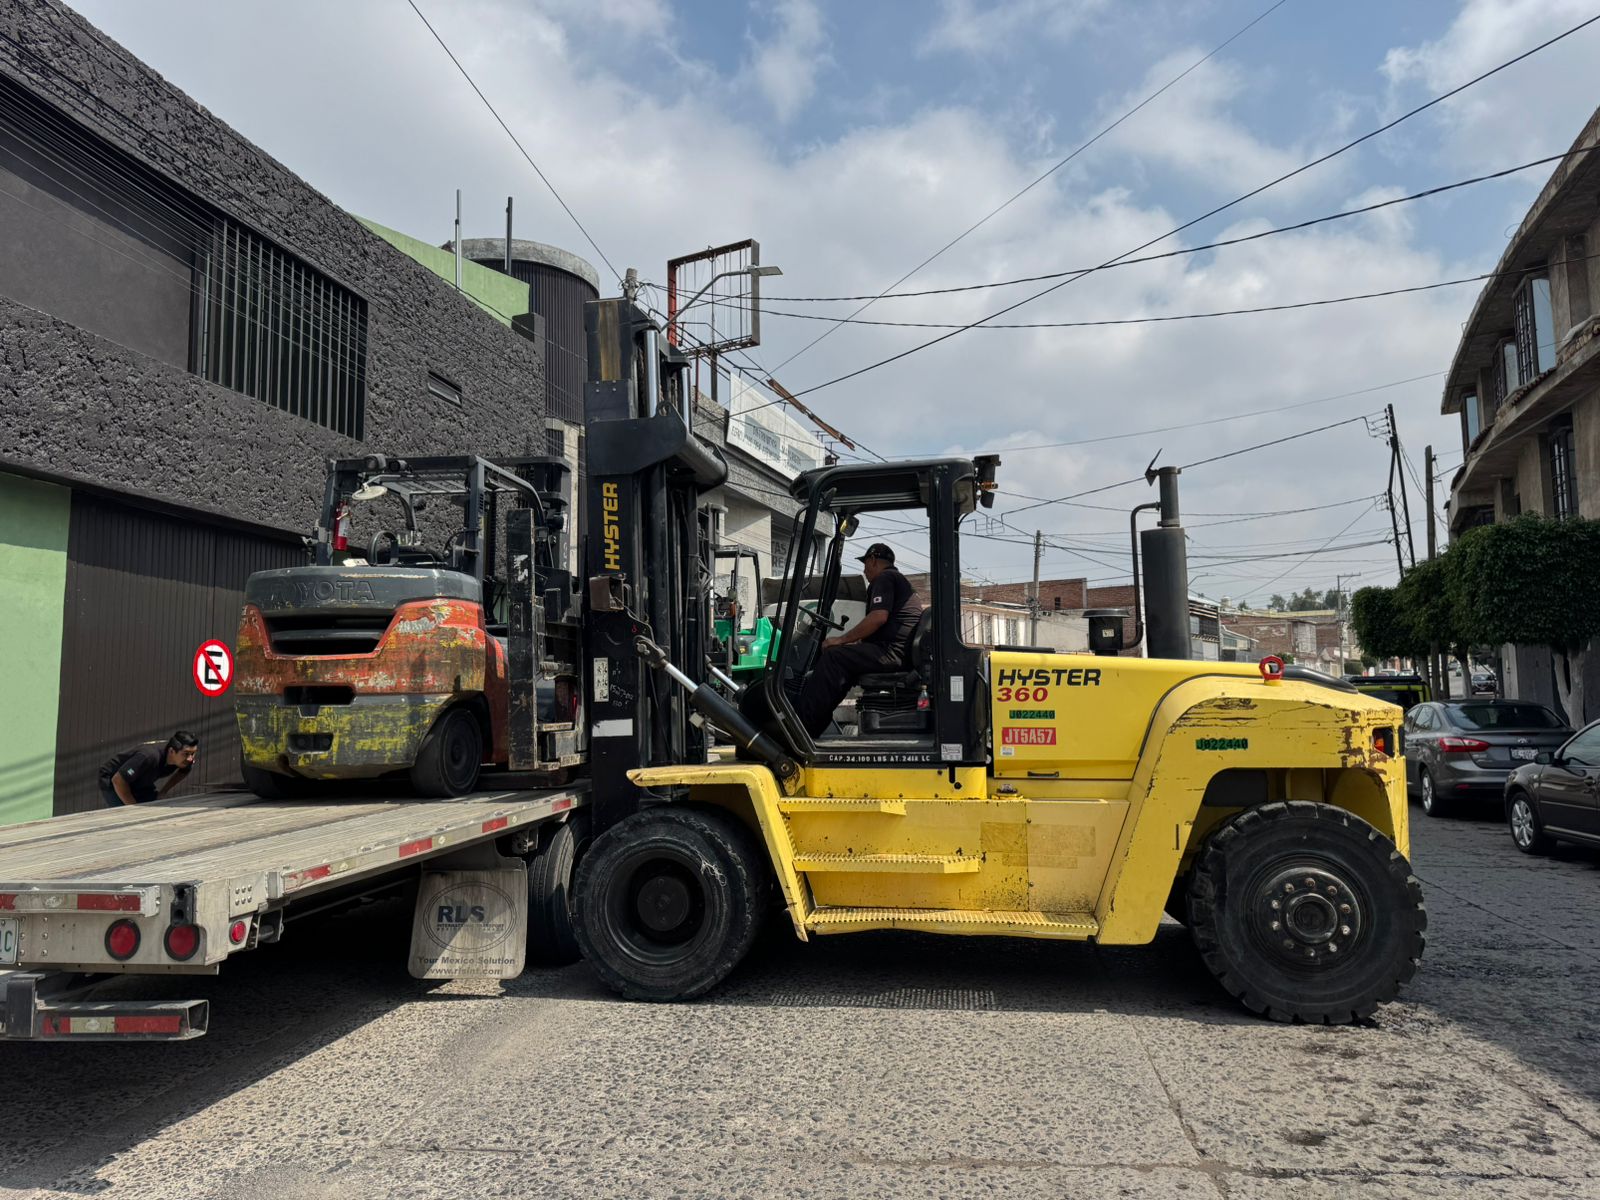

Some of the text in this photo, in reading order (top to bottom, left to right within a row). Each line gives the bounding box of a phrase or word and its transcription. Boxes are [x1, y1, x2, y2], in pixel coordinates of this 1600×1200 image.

[602, 482, 620, 571] HYSTER
[203, 650, 224, 684] E
[997, 668, 1102, 686] HYSTER
[996, 686, 1048, 702] 360
[1004, 728, 1055, 744] JT5A57
[438, 905, 485, 923] RLS
[418, 956, 515, 965] Your Mexico Solution
